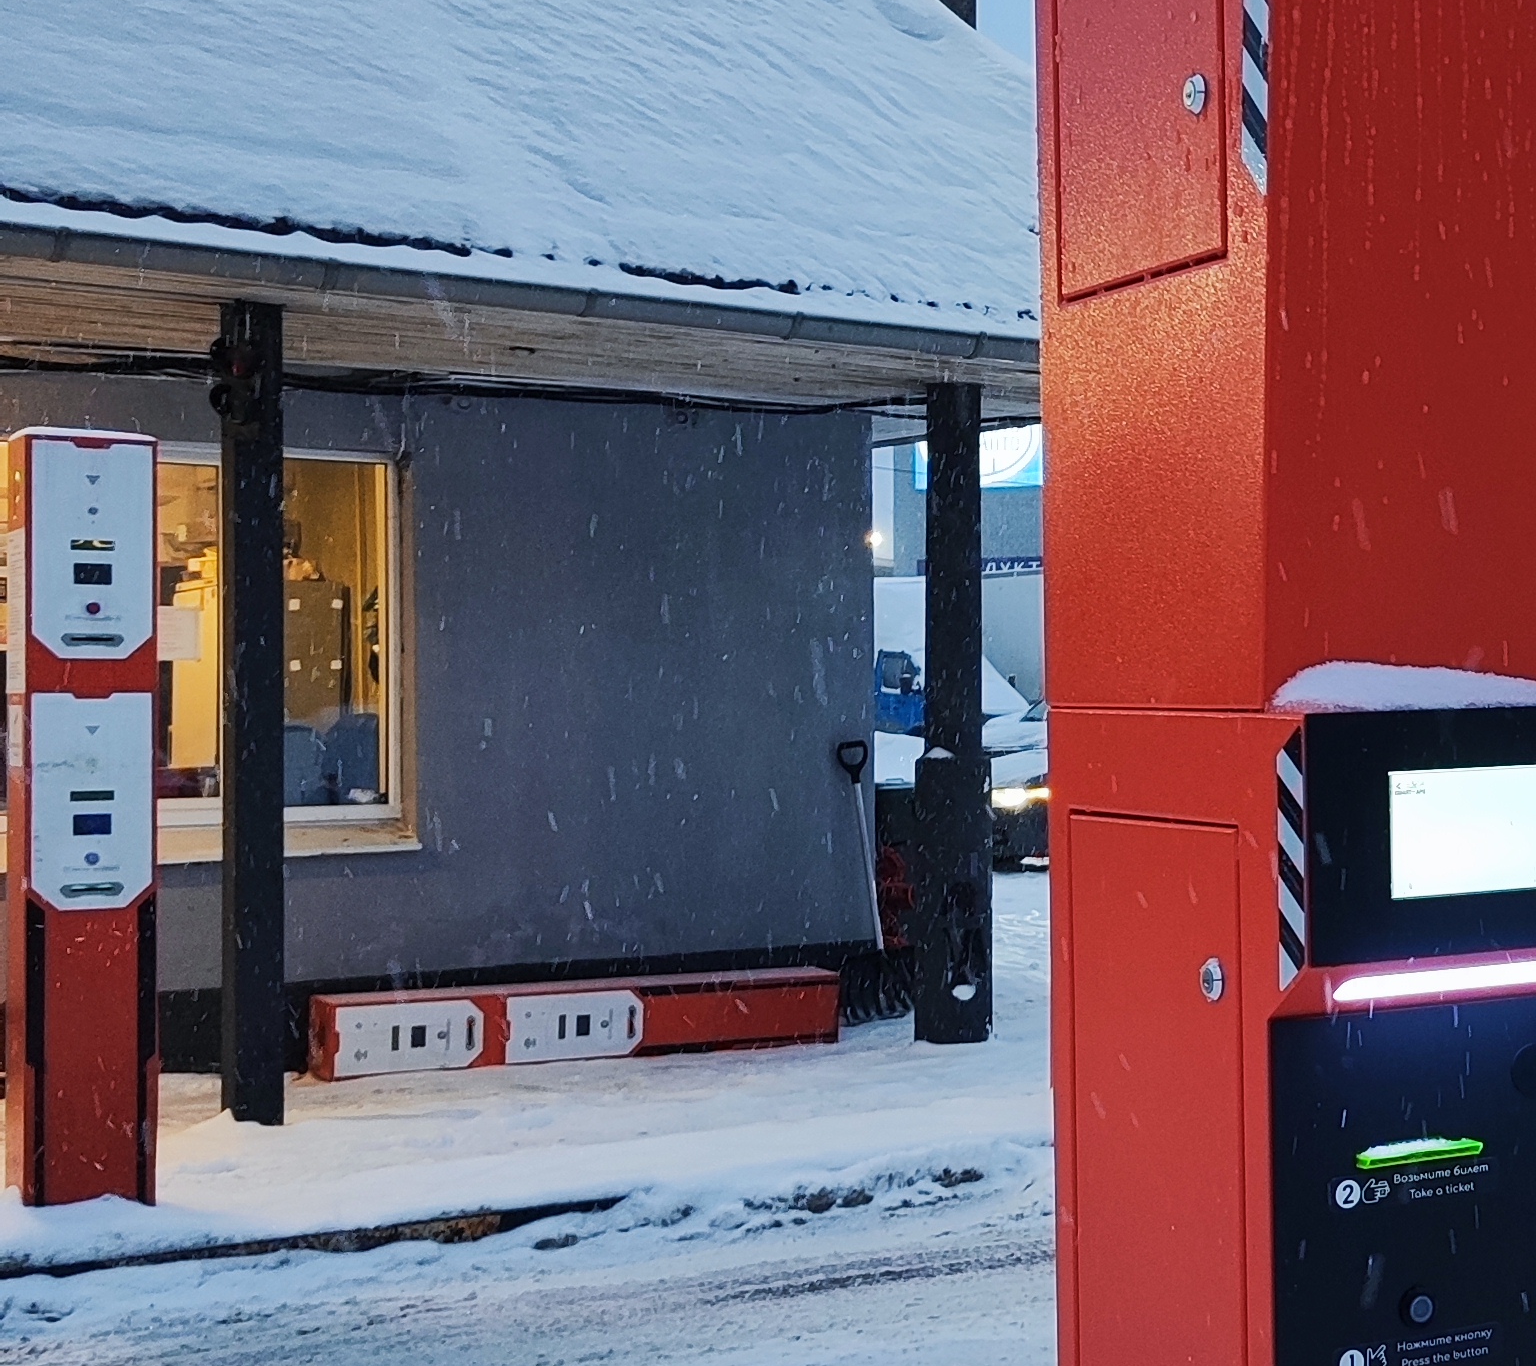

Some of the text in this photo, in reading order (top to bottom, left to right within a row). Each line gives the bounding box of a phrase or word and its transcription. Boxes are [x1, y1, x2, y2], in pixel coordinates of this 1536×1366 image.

[1393, 1164, 1489, 1184] Возьмите билет
[1342, 1183, 1355, 1205] 2
[1408, 1182, 1475, 1200] Take a ticket
[1397, 1328, 1493, 1353] Нажмите кнопку
[1432, 1352, 1451, 1364] the
[1452, 1346, 1489, 1360] button
